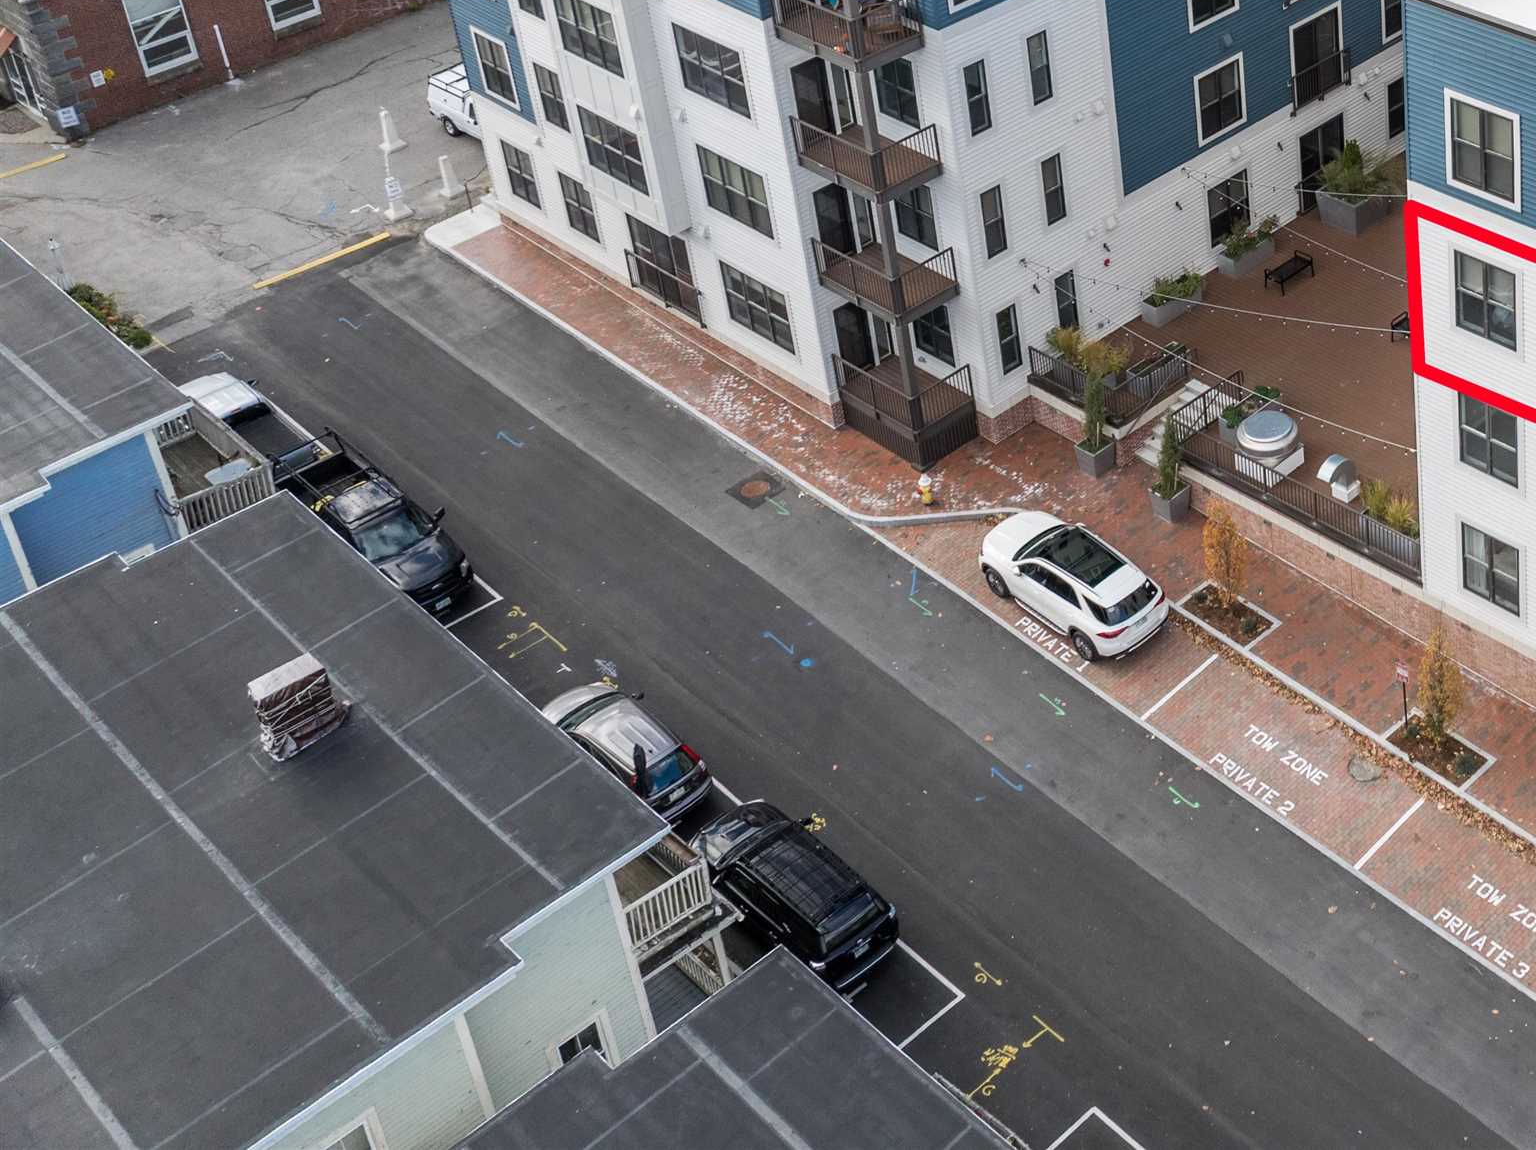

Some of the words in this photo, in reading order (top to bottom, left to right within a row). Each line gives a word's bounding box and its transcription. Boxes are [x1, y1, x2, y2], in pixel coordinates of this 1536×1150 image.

[1014, 616, 1078, 663] PRIVATE
[1076, 660, 1090, 672] 1
[1244, 724, 1280, 752] TOW
[1280, 750, 1328, 786] ZONE
[1208, 752, 1280, 805] PRIVATE
[1277, 800, 1295, 821] 2
[1467, 874, 1506, 907] TOW
[1433, 908, 1514, 968] PRIVATE
[1512, 961, 1530, 979] 3
